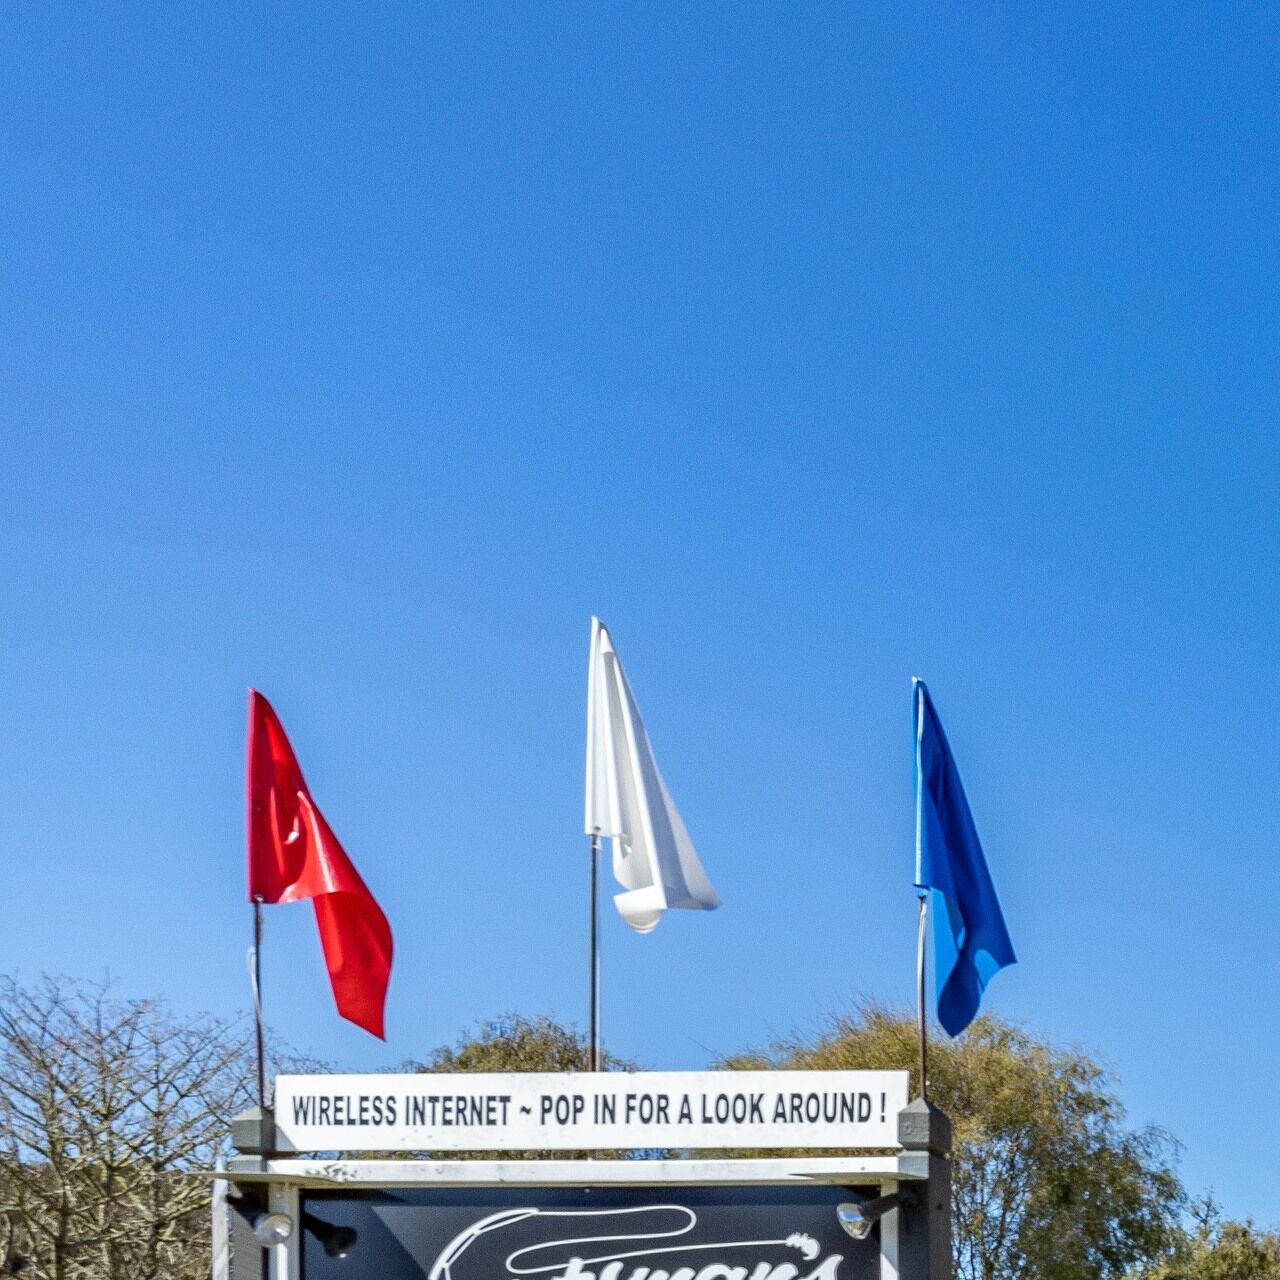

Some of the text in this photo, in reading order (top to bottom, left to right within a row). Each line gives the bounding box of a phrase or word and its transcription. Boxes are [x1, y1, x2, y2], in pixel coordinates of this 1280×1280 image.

[293, 1096, 397, 1126] WIRELESS
[405, 1096, 511, 1126] INTERNET
[540, 1095, 585, 1125] POP
[593, 1094, 616, 1124] IN
[625, 1094, 670, 1124] FOR
[678, 1094, 693, 1124] A
[701, 1093, 765, 1124] LOOK
